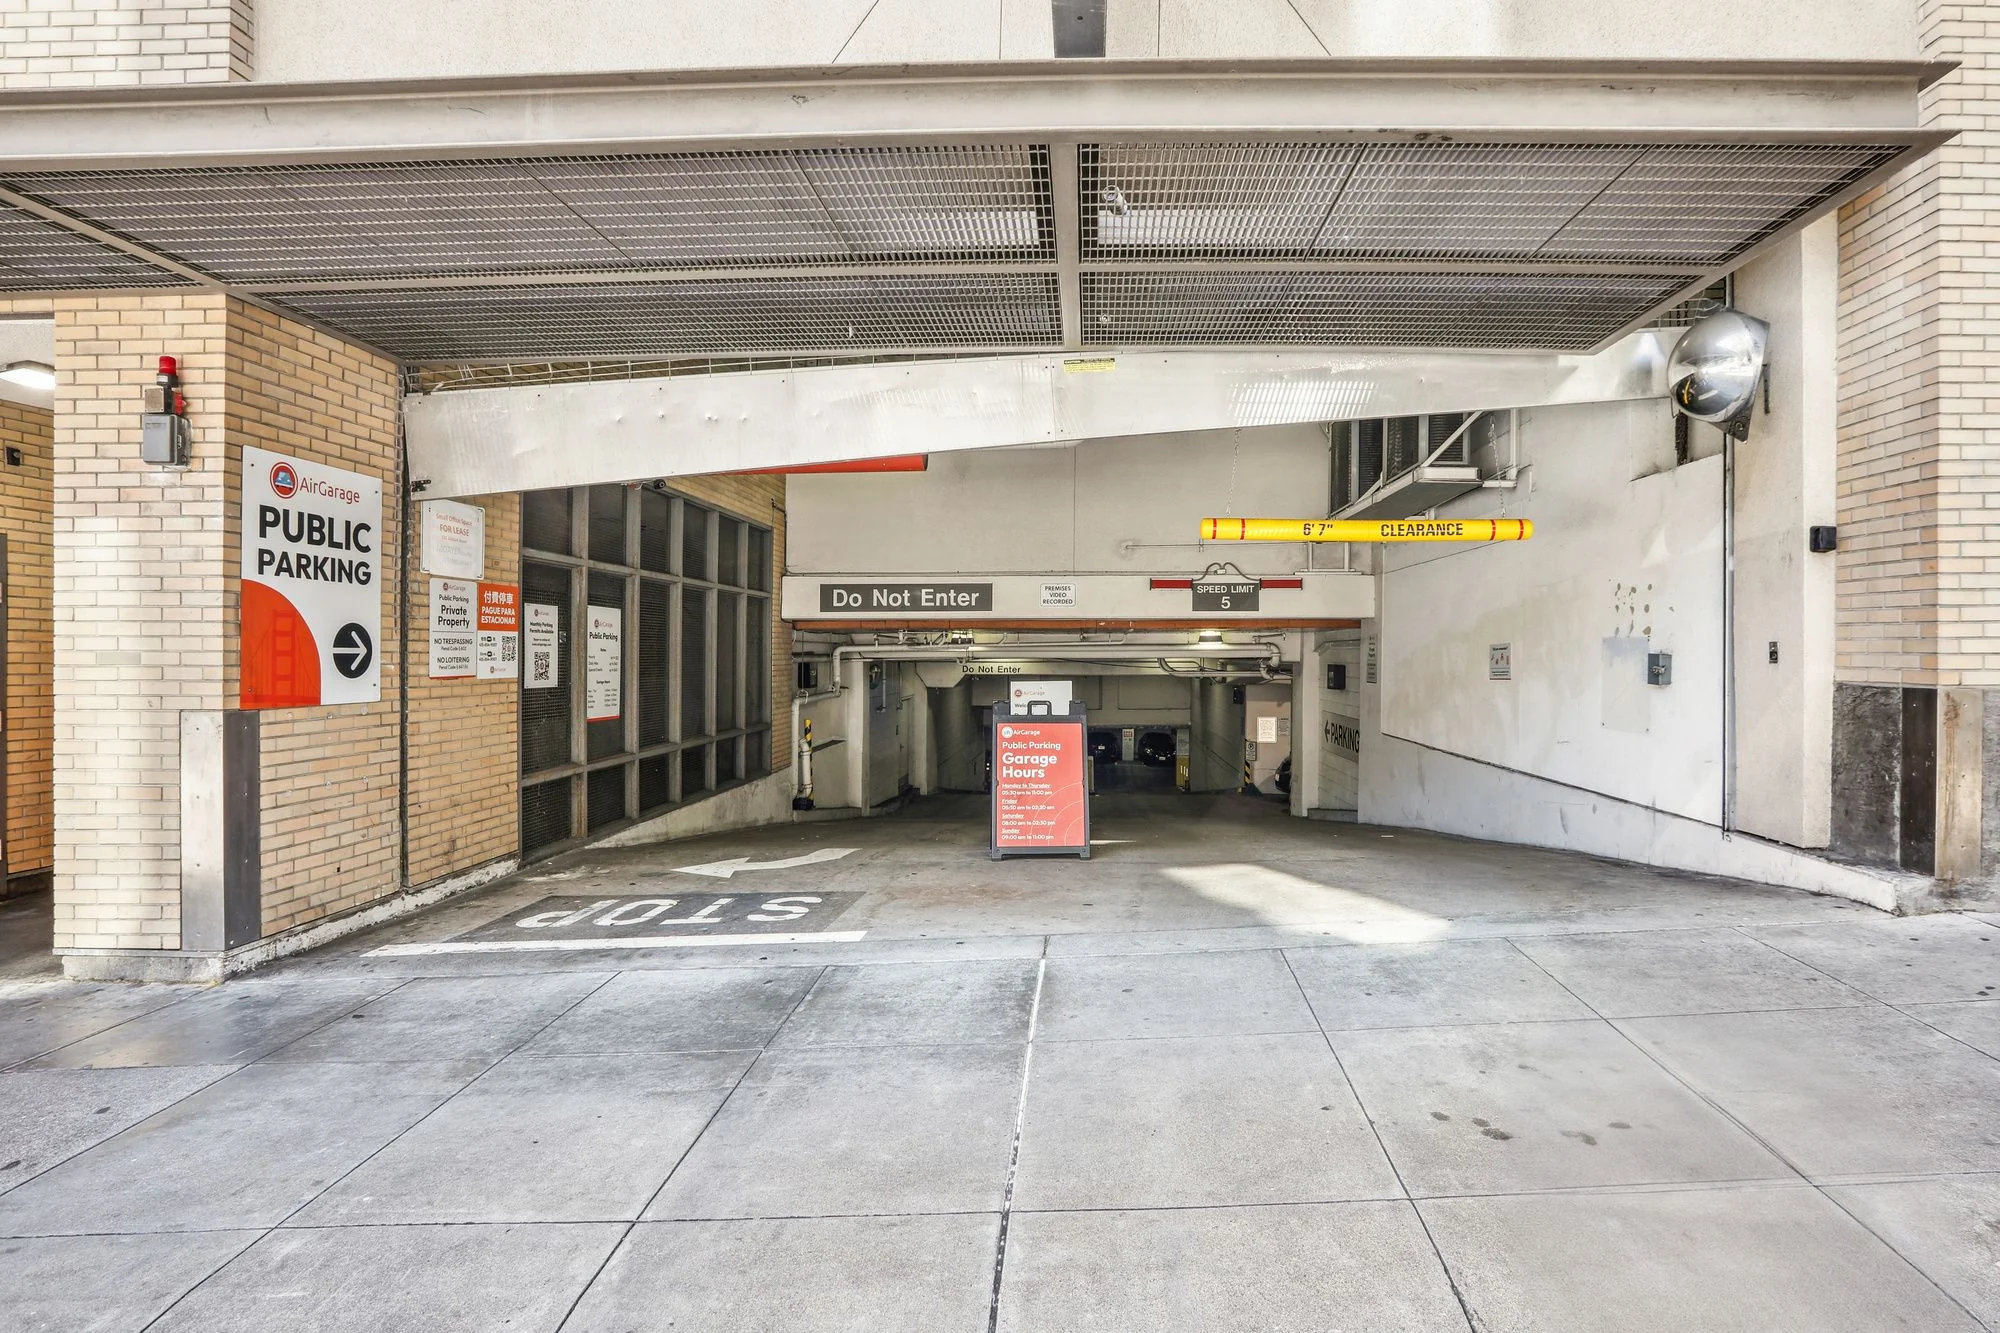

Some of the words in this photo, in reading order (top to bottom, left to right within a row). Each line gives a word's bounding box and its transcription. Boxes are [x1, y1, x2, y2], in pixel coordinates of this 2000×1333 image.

[300, 477, 360, 505] AirGarage
[259, 504, 372, 554] PUBLIC
[440, 524, 452, 534] FOR
[453, 527, 470, 537] LEASE
[1381, 523, 1464, 537] CLEARANCE
[258, 547, 372, 586] PARKING
[1197, 584, 1228, 594] SPEED
[1231, 584, 1255, 594] LIMIT
[438, 594, 452, 602] Public
[453, 595, 470, 604] Parking
[832, 588, 862, 608] Do
[872, 588, 911, 608] Not
[921, 588, 980, 608] Enter
[1221, 596, 1231, 610] 5
[441, 604, 467, 615] Private
[481, 606, 500, 615] PAGUE
[501, 607, 516, 616] PARA
[437, 616, 470, 628] Property
[481, 615, 516, 625] ESTACIONAR
[589, 631, 602, 640] Public
[603, 633, 618, 642] Parking
[445, 656, 470, 664] LOITERING
[962, 665, 974, 673] Do
[978, 665, 994, 673] Not
[997, 665, 1021, 673] Enter
[1330, 723, 1360, 753] PARKING
[1002, 741, 1027, 749] Public
[1029, 741, 1061, 751] Parking
[1002, 752, 1058, 767] Garage
[1002, 766, 1045, 778] Hours
[515, 896, 823, 928] STOP
